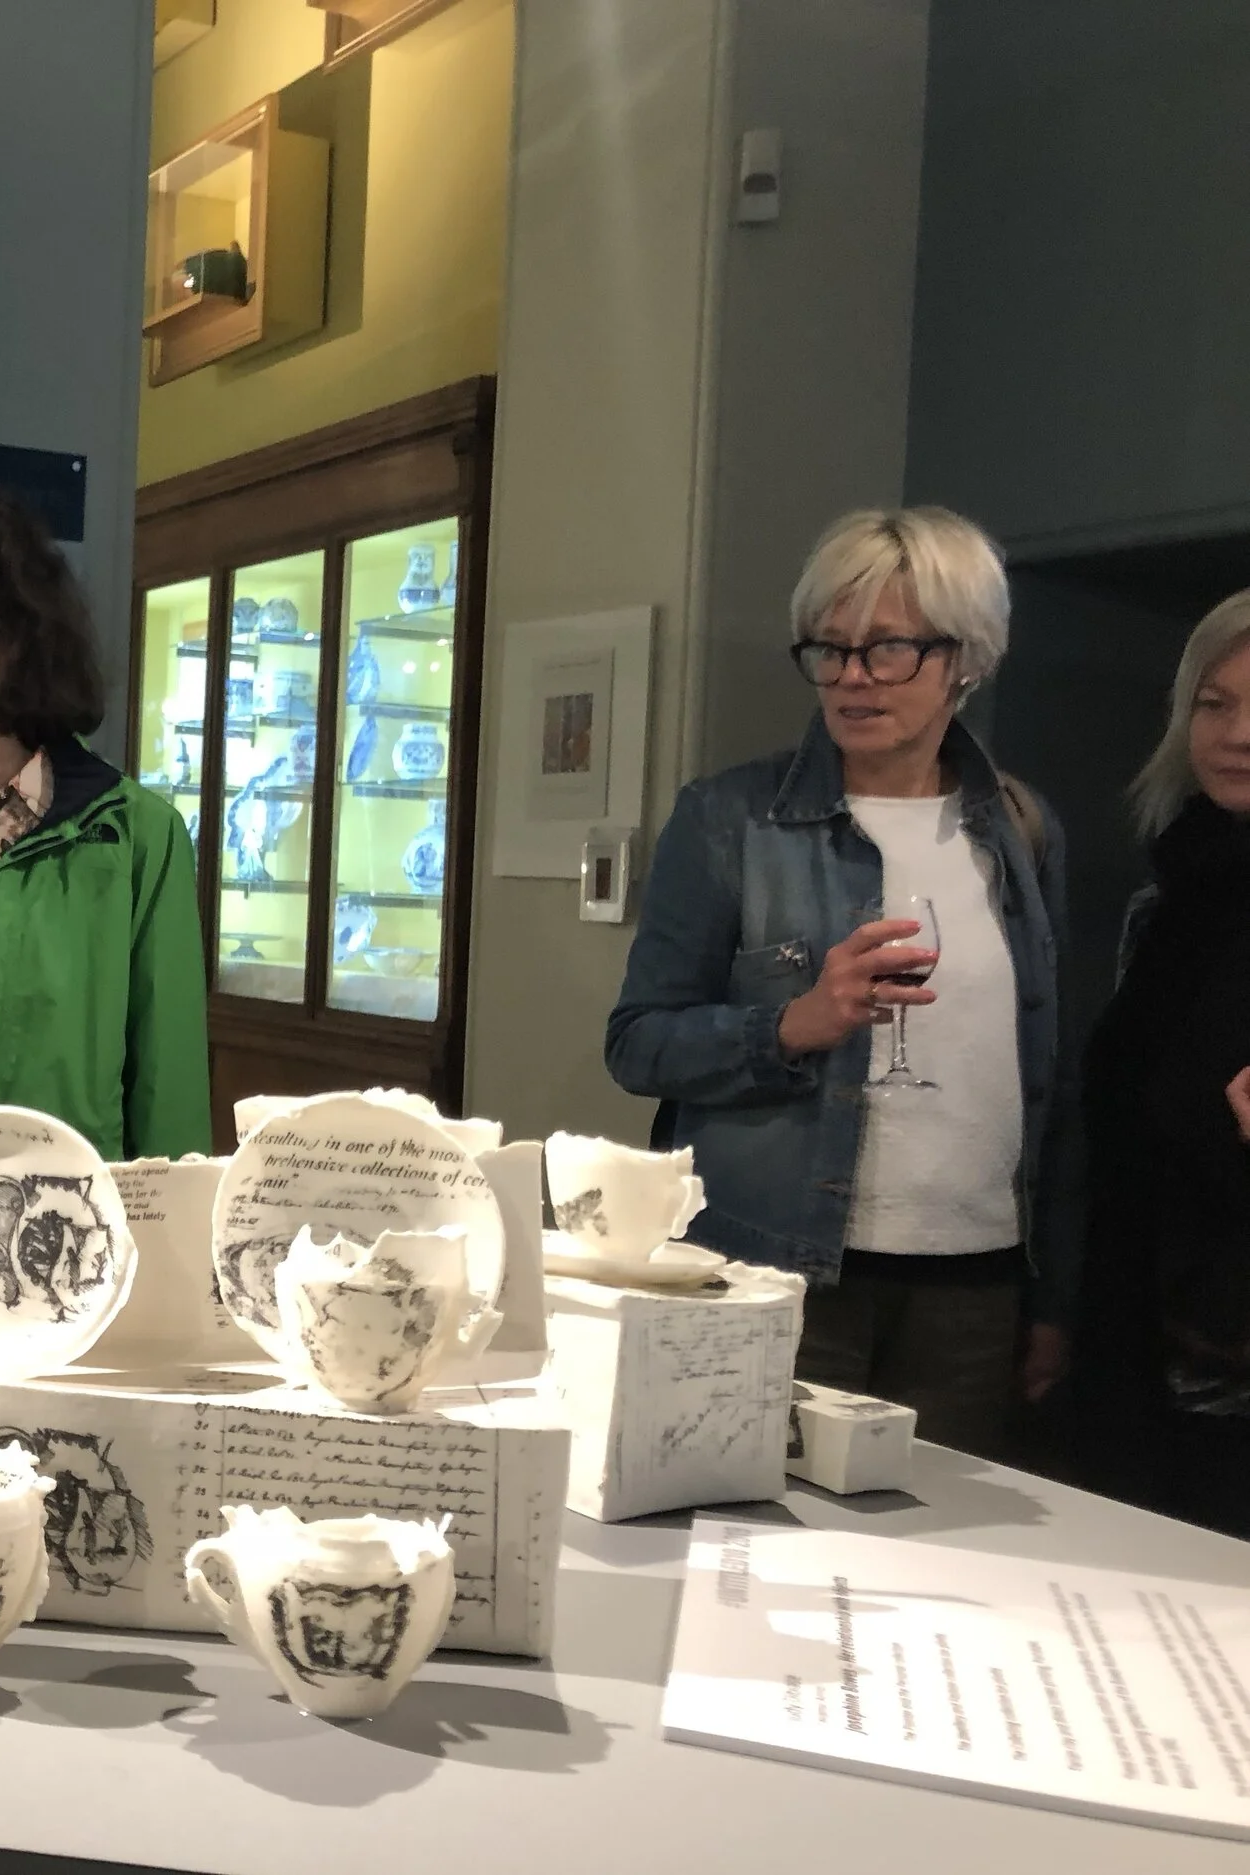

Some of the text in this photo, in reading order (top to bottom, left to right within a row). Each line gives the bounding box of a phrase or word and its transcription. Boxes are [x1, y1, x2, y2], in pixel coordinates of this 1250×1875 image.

[324, 1135, 342, 1151] in
[344, 1141, 375, 1155] one
[378, 1139, 397, 1159] of
[399, 1138, 425, 1159] the
[351, 1161, 439, 1182] collections
[441, 1168, 462, 1188] of
[126, 1211, 141, 1221] has
